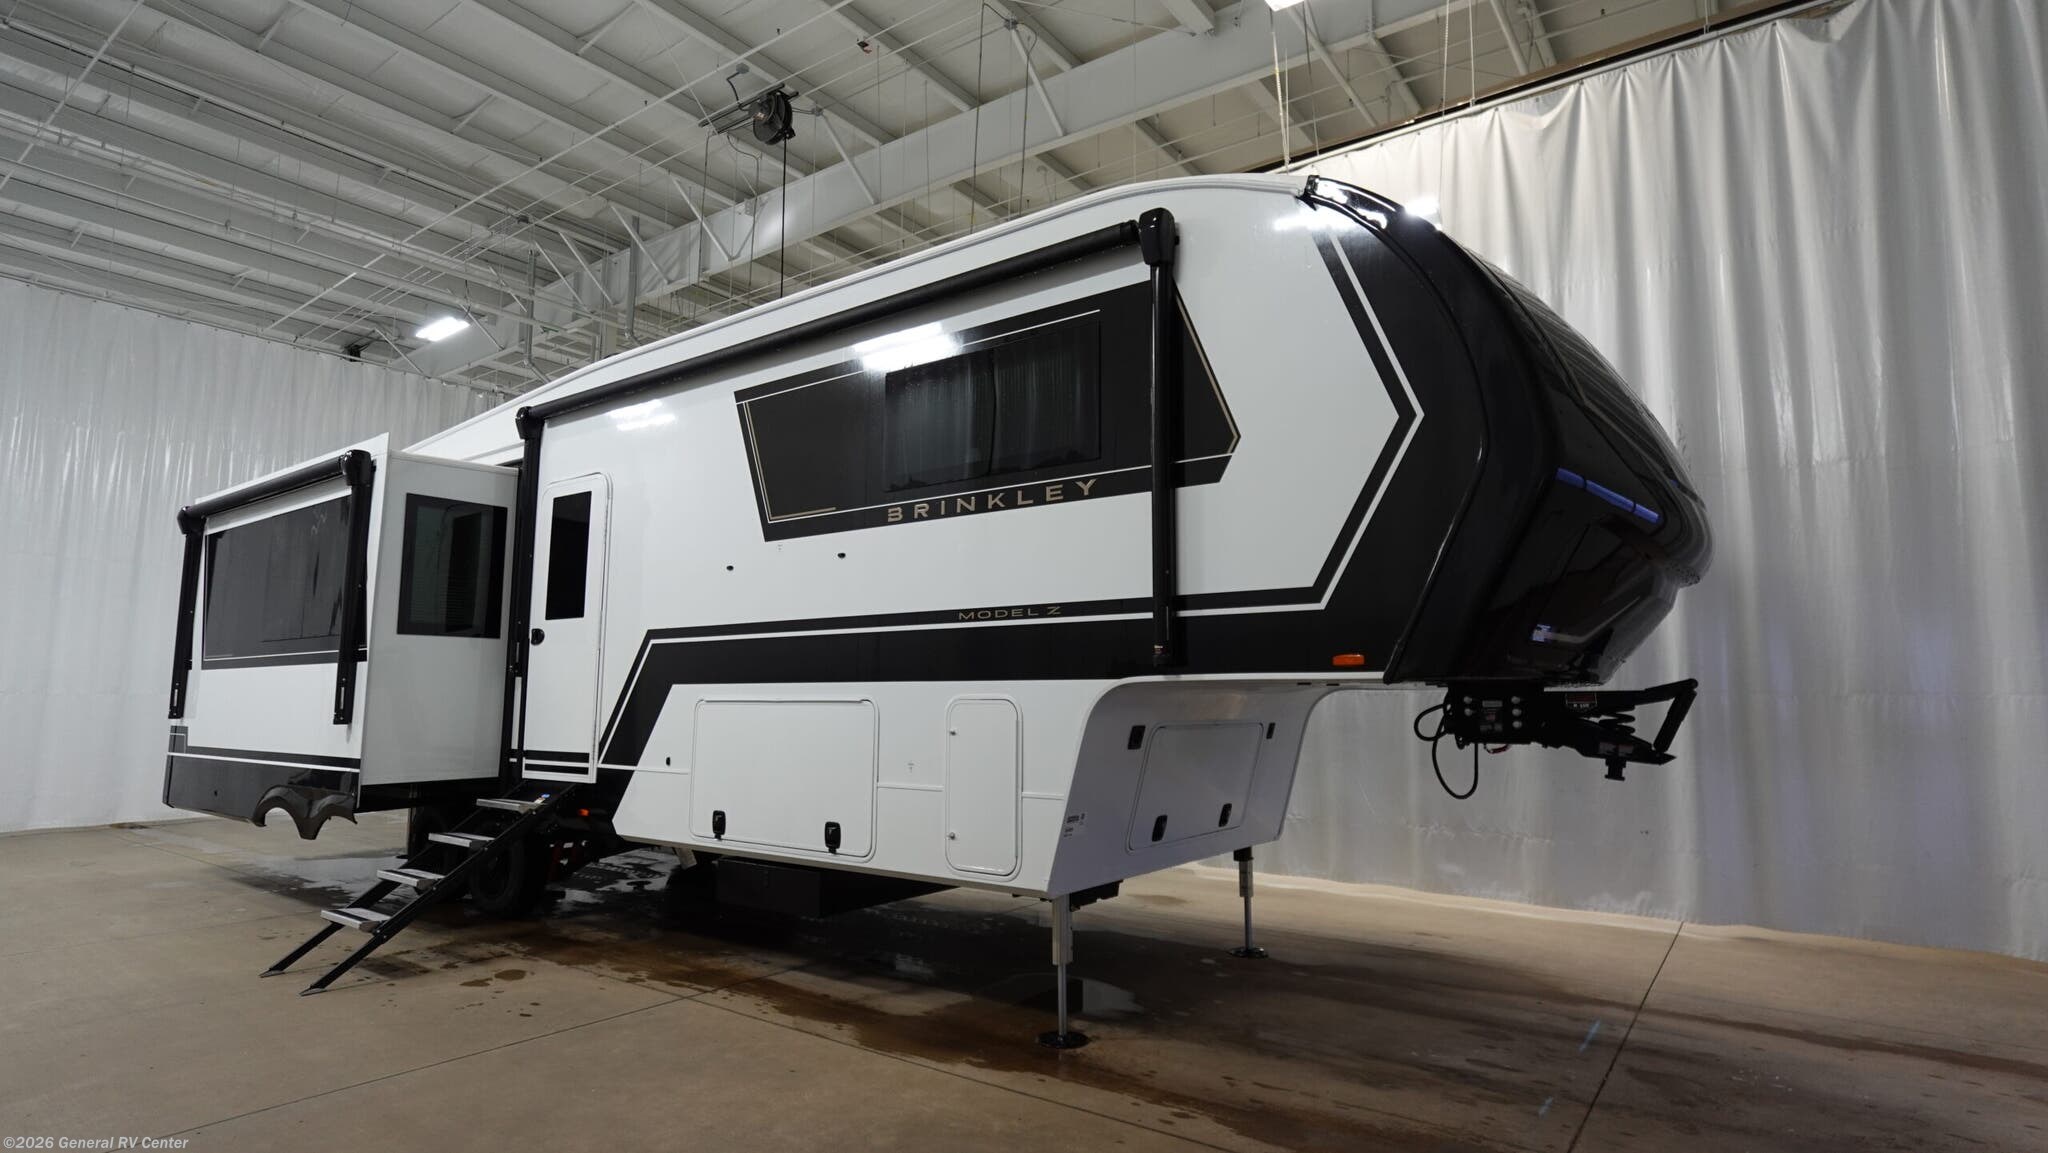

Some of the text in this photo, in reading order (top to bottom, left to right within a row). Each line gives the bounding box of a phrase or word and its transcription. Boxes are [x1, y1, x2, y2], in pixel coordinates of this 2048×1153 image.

[887, 479, 1097, 523] BRINKLEY
[958, 606, 1062, 621] MODEL Z
